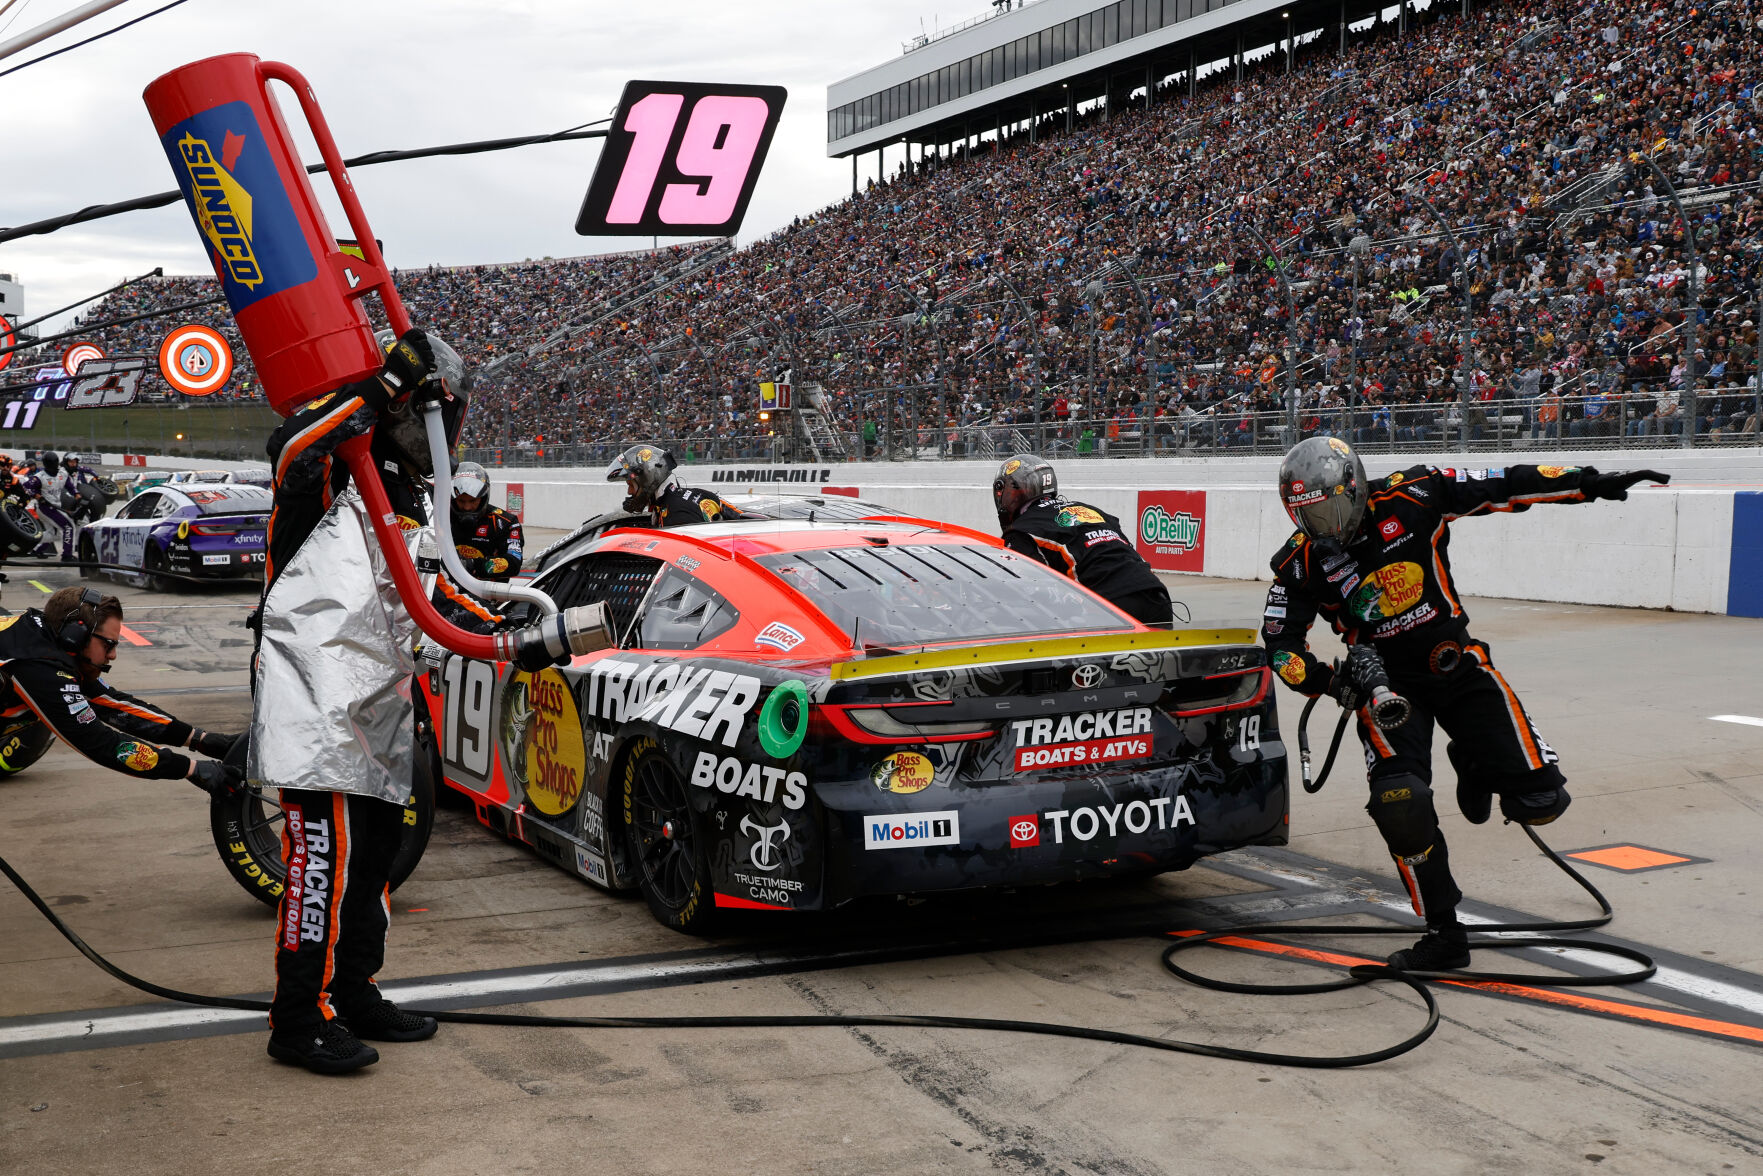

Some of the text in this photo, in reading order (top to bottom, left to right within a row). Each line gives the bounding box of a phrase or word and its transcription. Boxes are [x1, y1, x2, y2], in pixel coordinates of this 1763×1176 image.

[605, 93, 769, 224] 19
[181, 143, 259, 281] SUNOCO
[344, 268, 360, 289] 1
[69, 359, 144, 406] 23
[3, 401, 42, 428] 11
[712, 470, 830, 483] MARTINSVILLE
[1042, 474, 1052, 486] 19
[1288, 489, 1323, 503] TRACKER
[122, 526, 145, 549] xfinity
[234, 534, 263, 544] xfinity
[1143, 507, 1200, 547] O'Reilly
[101, 527, 120, 564] 23
[1156, 546, 1184, 555] AUTO PARTS
[1342, 576, 1359, 595] Lance
[1374, 562, 1407, 585] Bass
[1384, 578, 1405, 597] Pro
[1389, 582, 1423, 607] Shops
[1377, 602, 1432, 634] TRACKER
[761, 624, 800, 648] Lance
[529, 671, 563, 718] Bass
[588, 659, 761, 748] TRACKER
[445, 655, 494, 776] 19
[1011, 707, 1152, 747] TRACKER
[533, 707, 558, 757] Pro
[1238, 714, 1260, 752] 19
[896, 753, 921, 767] Bass
[1020, 739, 1147, 768] BOATS & ATVs
[535, 745, 578, 810] Shops
[691, 751, 808, 810] BOATS
[896, 765, 916, 777] Pro
[898, 776, 928, 790] Shops
[872, 820, 929, 842] Mobil
[1044, 795, 1196, 844] TOYOTA
[229, 841, 285, 897] EAGLE
[577, 852, 597, 876] Mobil
[284, 810, 306, 946] BOATS & OFF ROAD
[301, 818, 330, 944] TRACKER
[734, 872, 803, 892] TRUETIMBER
[749, 886, 789, 903] CAMO
